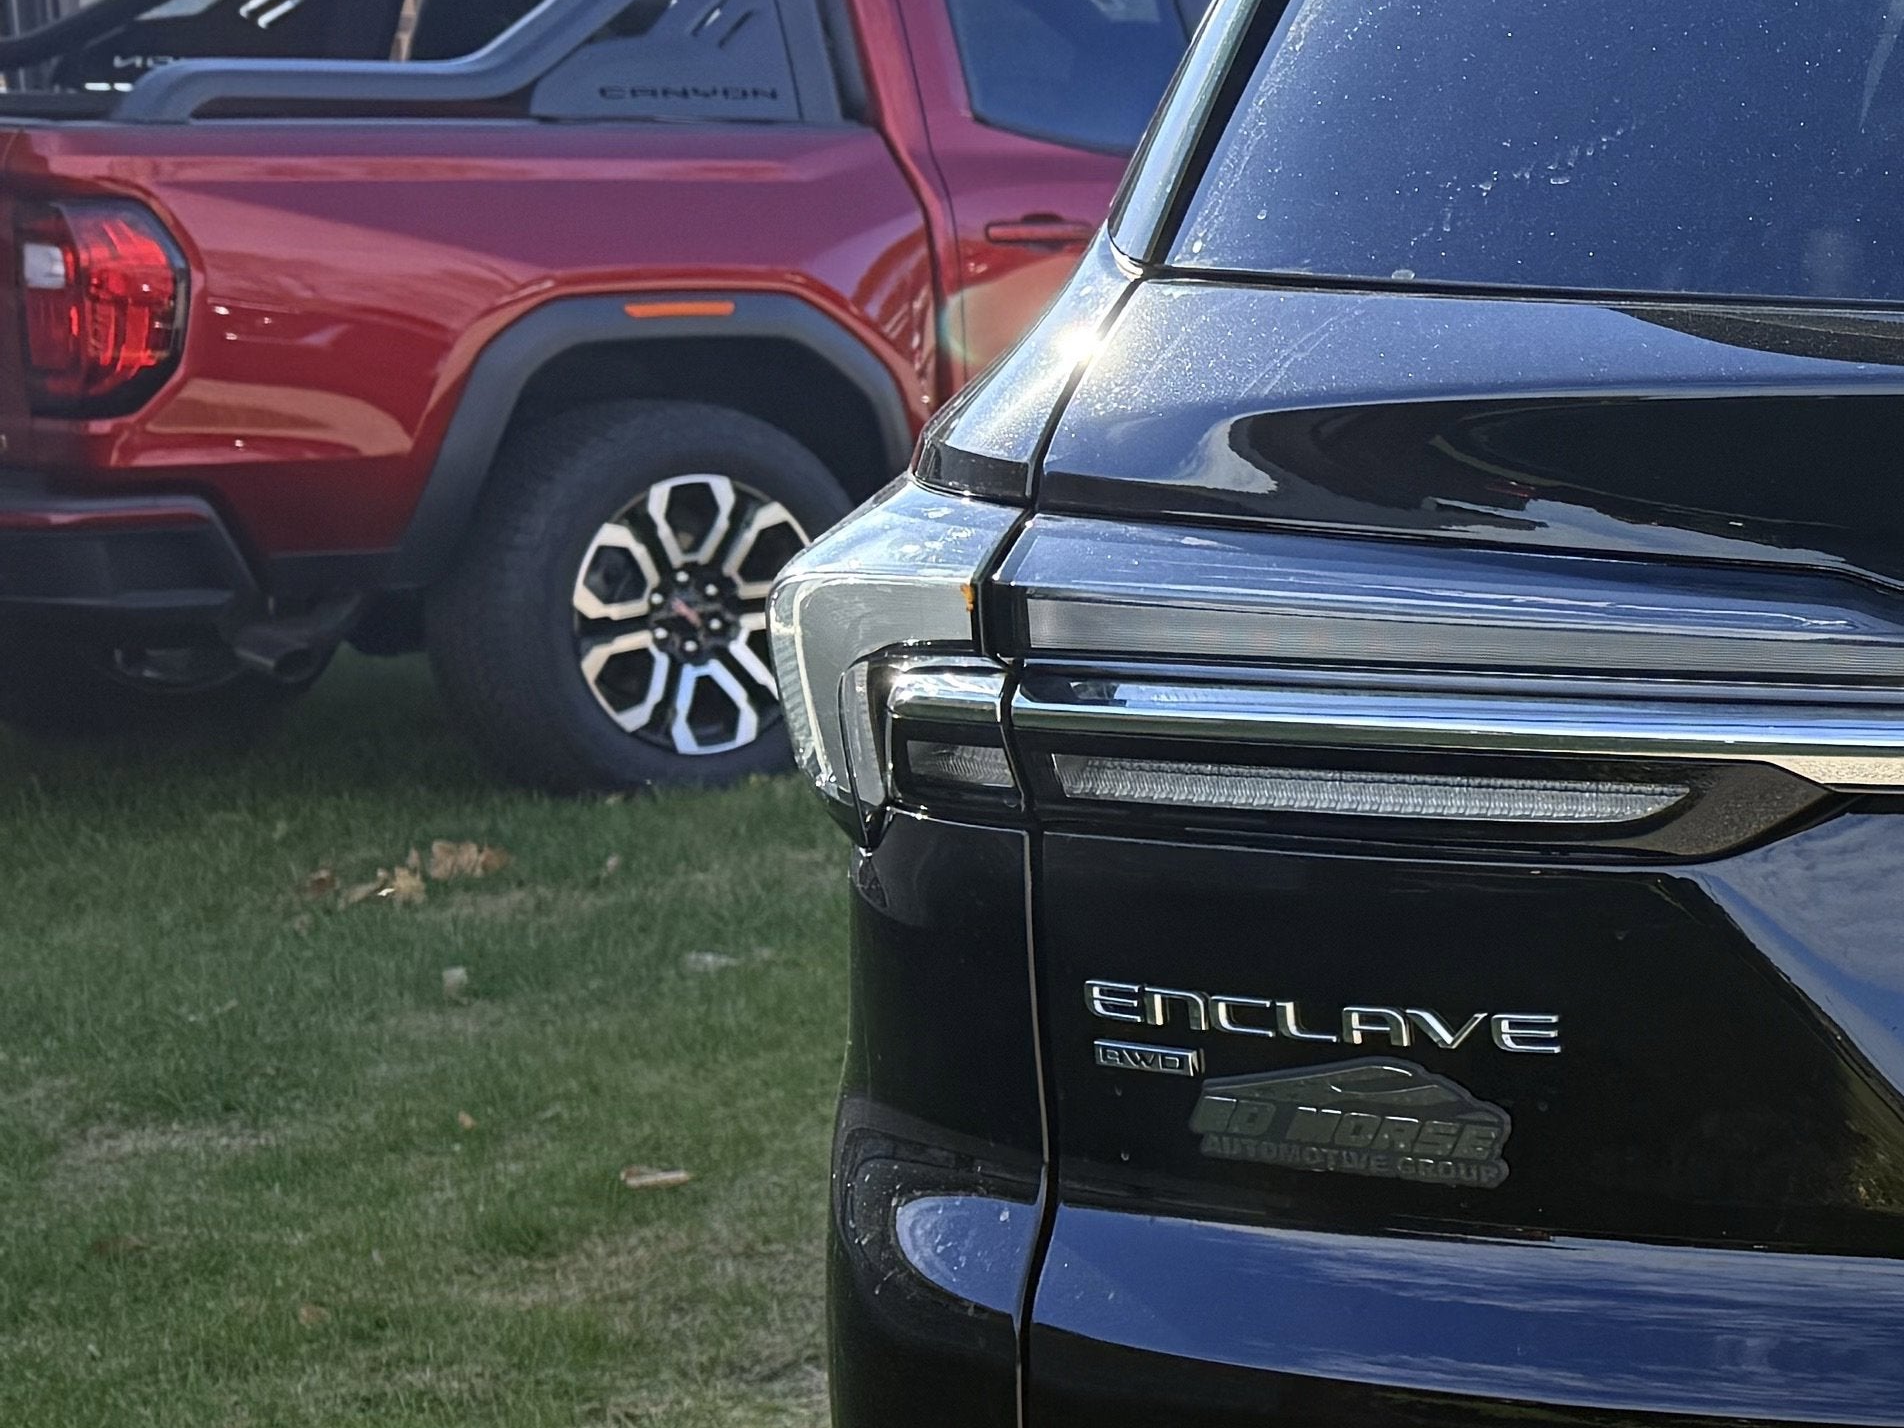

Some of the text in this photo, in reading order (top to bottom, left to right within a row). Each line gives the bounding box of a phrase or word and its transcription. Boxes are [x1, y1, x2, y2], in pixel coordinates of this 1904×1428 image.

[1084, 979, 1562, 1054] ENCLAVE
[1099, 1046, 1185, 1072] AWD
[1200, 1133, 1502, 1184] AUTOMOTIVE GROUP
